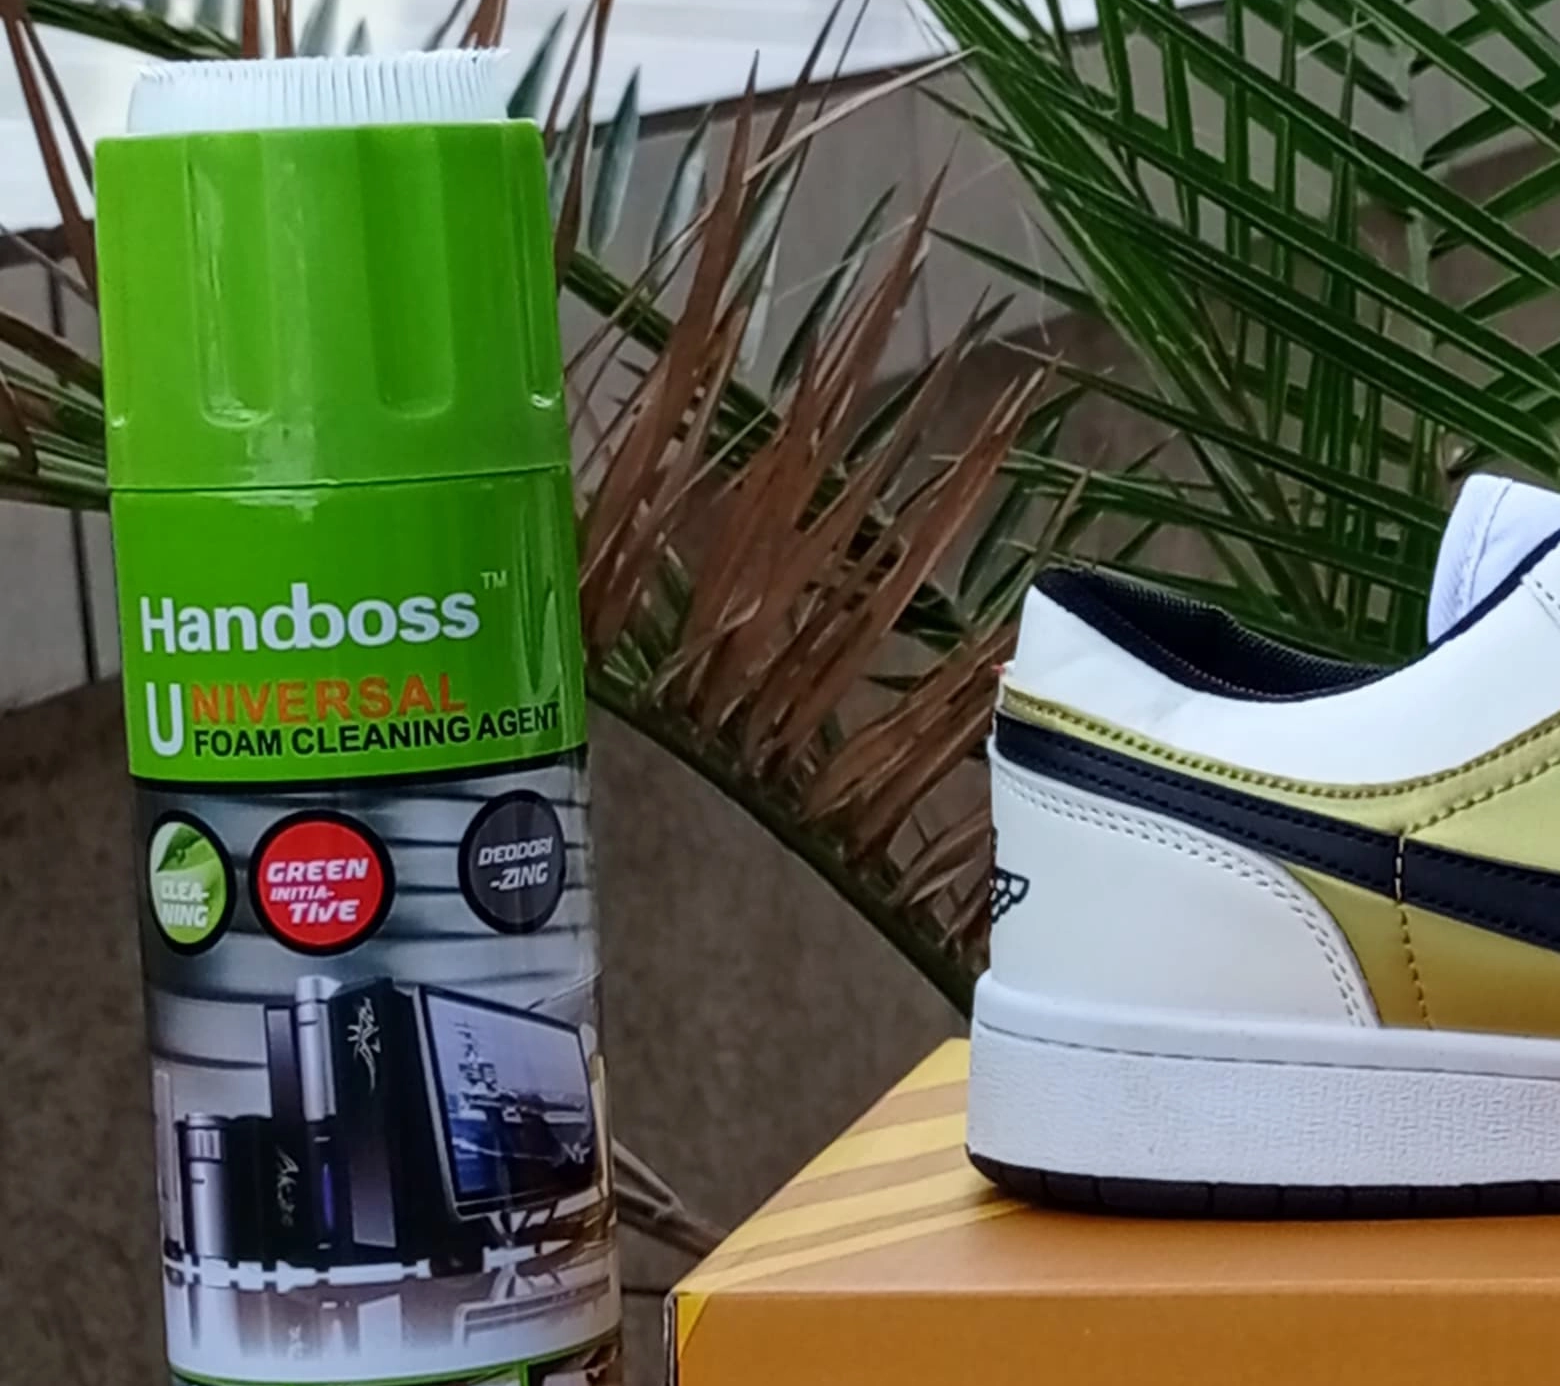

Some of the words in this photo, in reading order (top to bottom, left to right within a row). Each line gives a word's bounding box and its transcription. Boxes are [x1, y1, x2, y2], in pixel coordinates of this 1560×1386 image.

[140, 583, 481, 653] Handboss
[194, 728, 283, 758] FOAM
[292, 715, 471, 754] CLEANING
[476, 701, 560, 740] AGENT
[267, 858, 369, 883] GREEN
[161, 902, 209, 928] NING
[289, 900, 360, 925] TIVE
